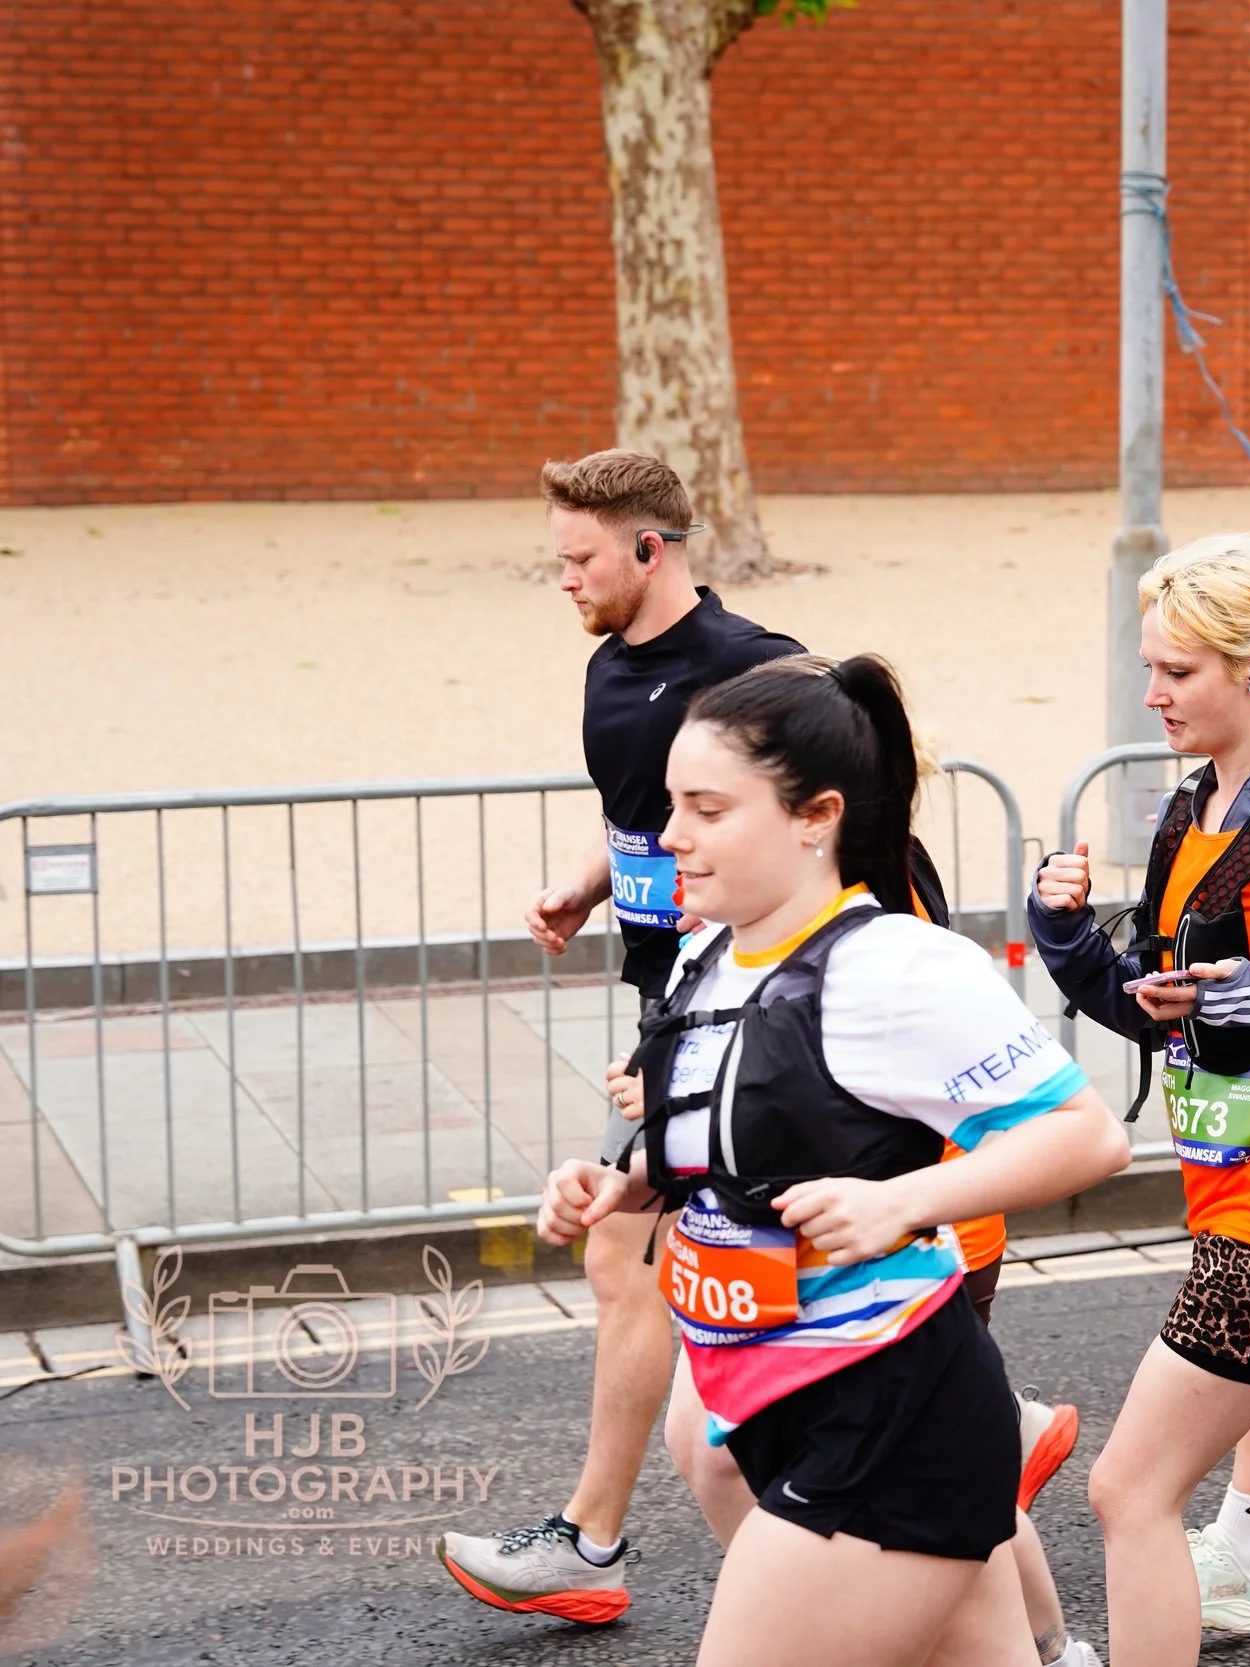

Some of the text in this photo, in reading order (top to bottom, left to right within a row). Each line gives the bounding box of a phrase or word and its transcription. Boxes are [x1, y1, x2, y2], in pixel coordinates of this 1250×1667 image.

[1161, 1071, 1176, 1090] FAITH
[1170, 1093, 1229, 1138] 3673
[671, 1260, 758, 1323] 5708
